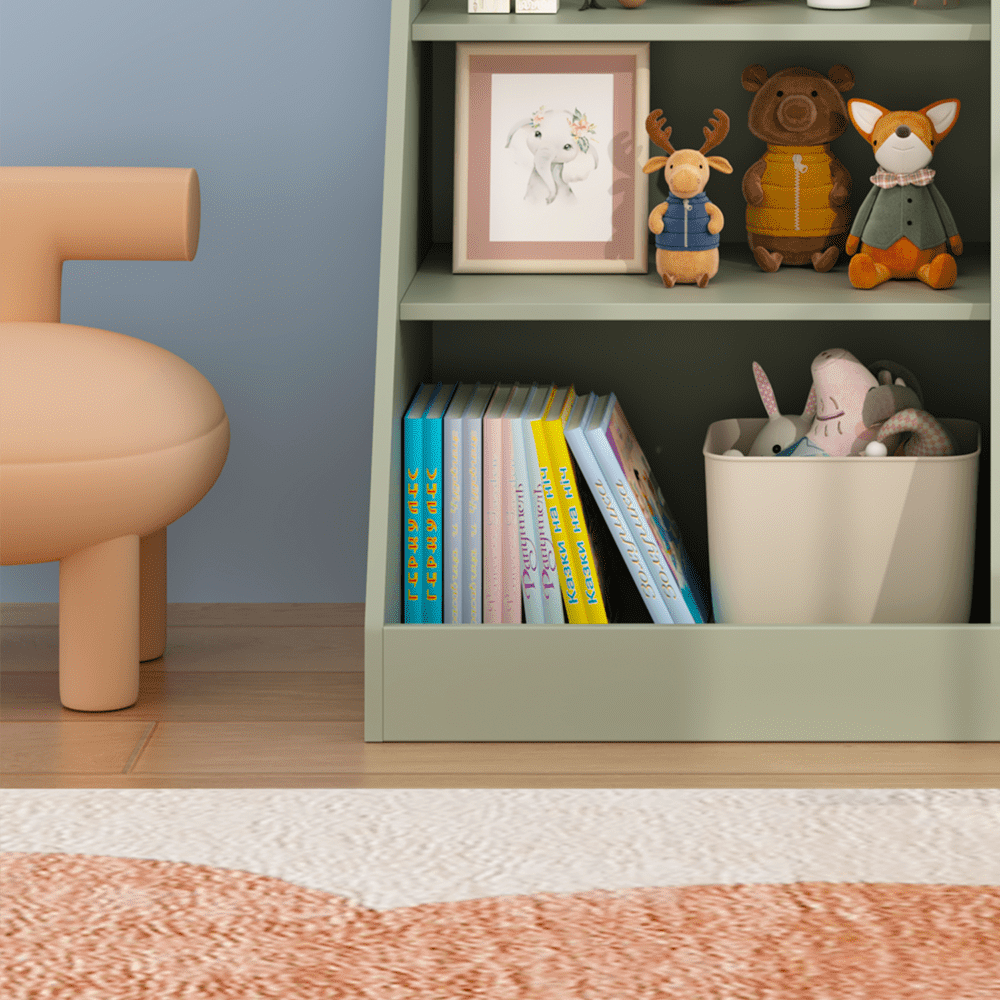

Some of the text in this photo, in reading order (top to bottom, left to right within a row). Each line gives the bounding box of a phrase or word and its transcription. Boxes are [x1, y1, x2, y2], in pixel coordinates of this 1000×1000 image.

[539, 466, 579, 605] Казки на ніч
[558, 466, 598, 605] Казки на ніч
[594, 479, 657, 600] Золушка
[613, 479, 678, 600] Золушка
